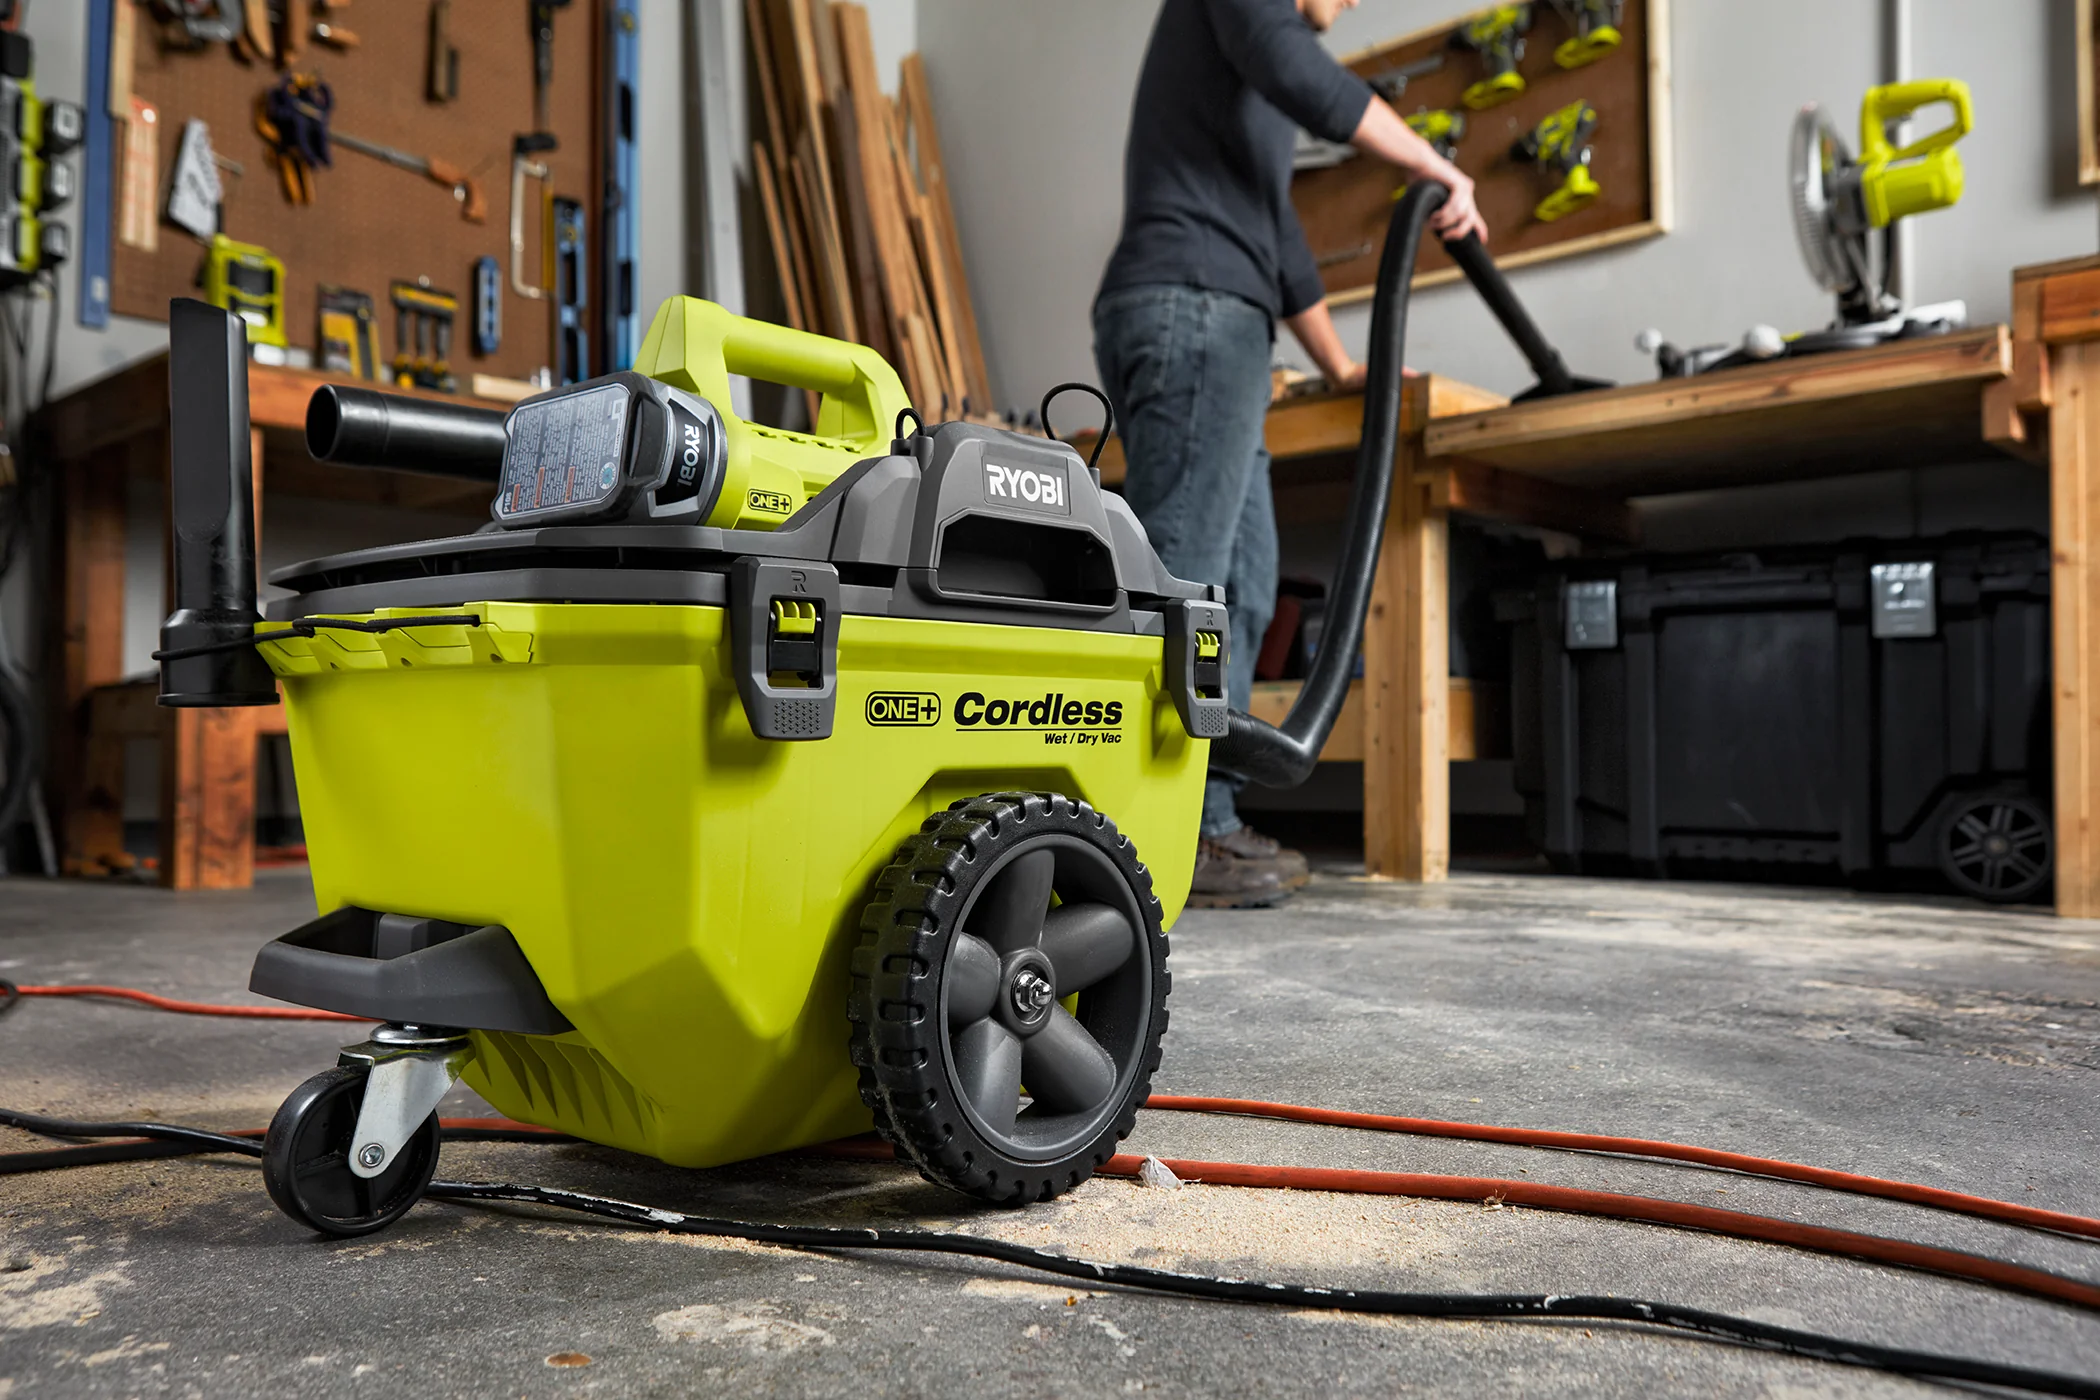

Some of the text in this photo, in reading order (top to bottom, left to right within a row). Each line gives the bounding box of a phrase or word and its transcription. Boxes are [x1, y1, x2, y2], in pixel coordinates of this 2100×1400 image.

[677, 423, 700, 487] RYOBI
[985, 463, 1064, 507] RYOBI
[749, 491, 790, 512] ONE+
[791, 570, 807, 593] R
[1205, 609, 1214, 627] R
[868, 691, 1123, 726] ONE+ Cordless
[1044, 733, 1068, 745] Wet
[1077, 732, 1099, 746] Dry
[1101, 732, 1122, 744] Vac
